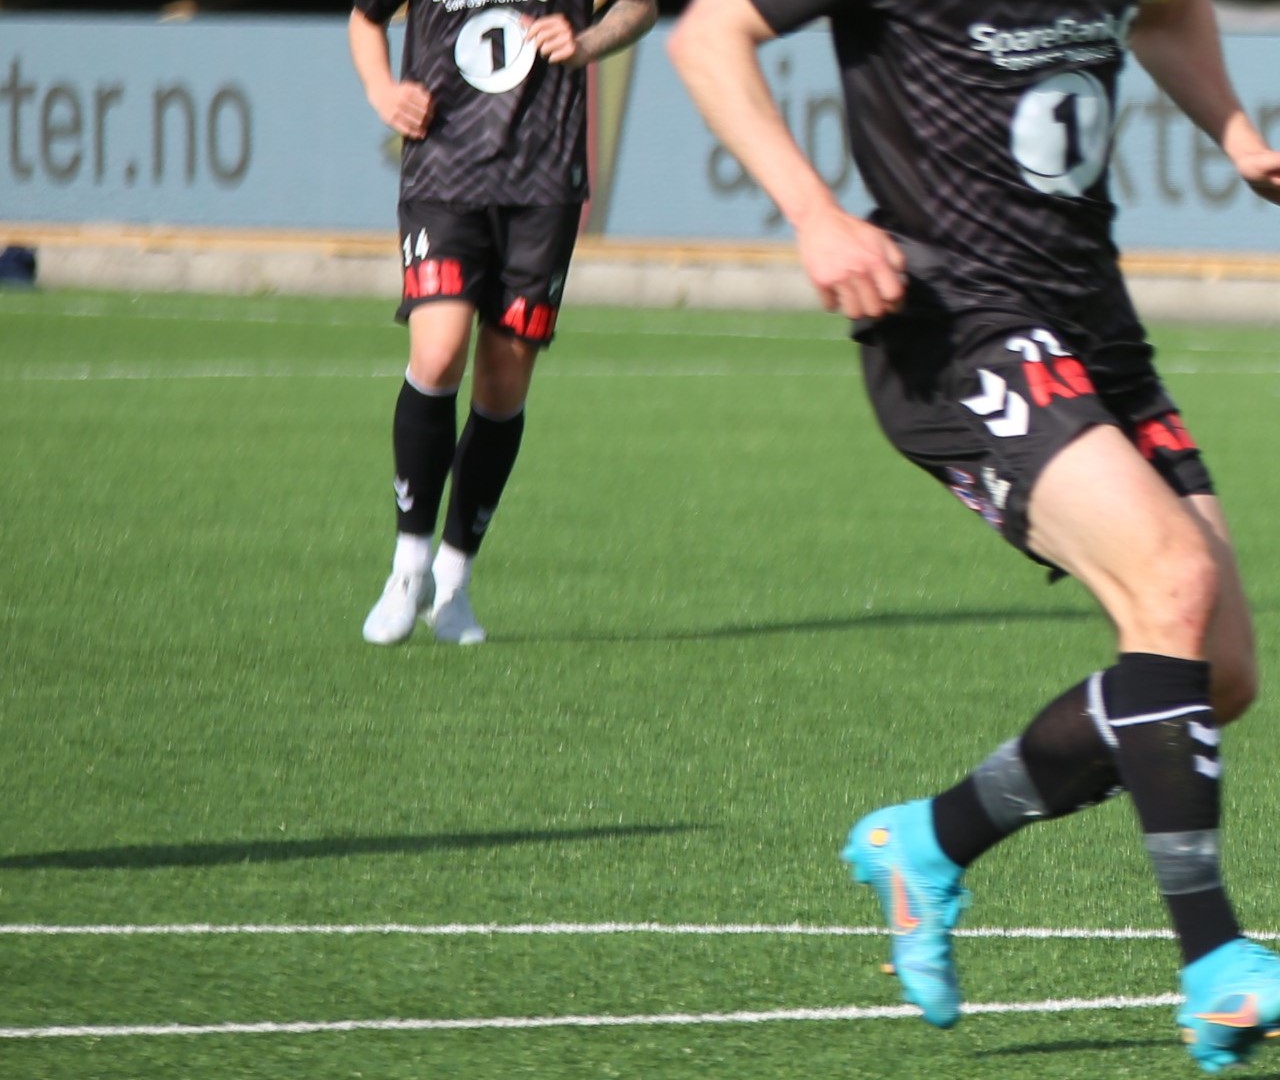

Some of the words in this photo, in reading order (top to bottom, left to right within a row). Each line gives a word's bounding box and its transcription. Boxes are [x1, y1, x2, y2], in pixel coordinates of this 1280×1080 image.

[480, 26, 507, 77] 1
[402, 227, 431, 267] 14
[403, 258, 465, 299] ABB
